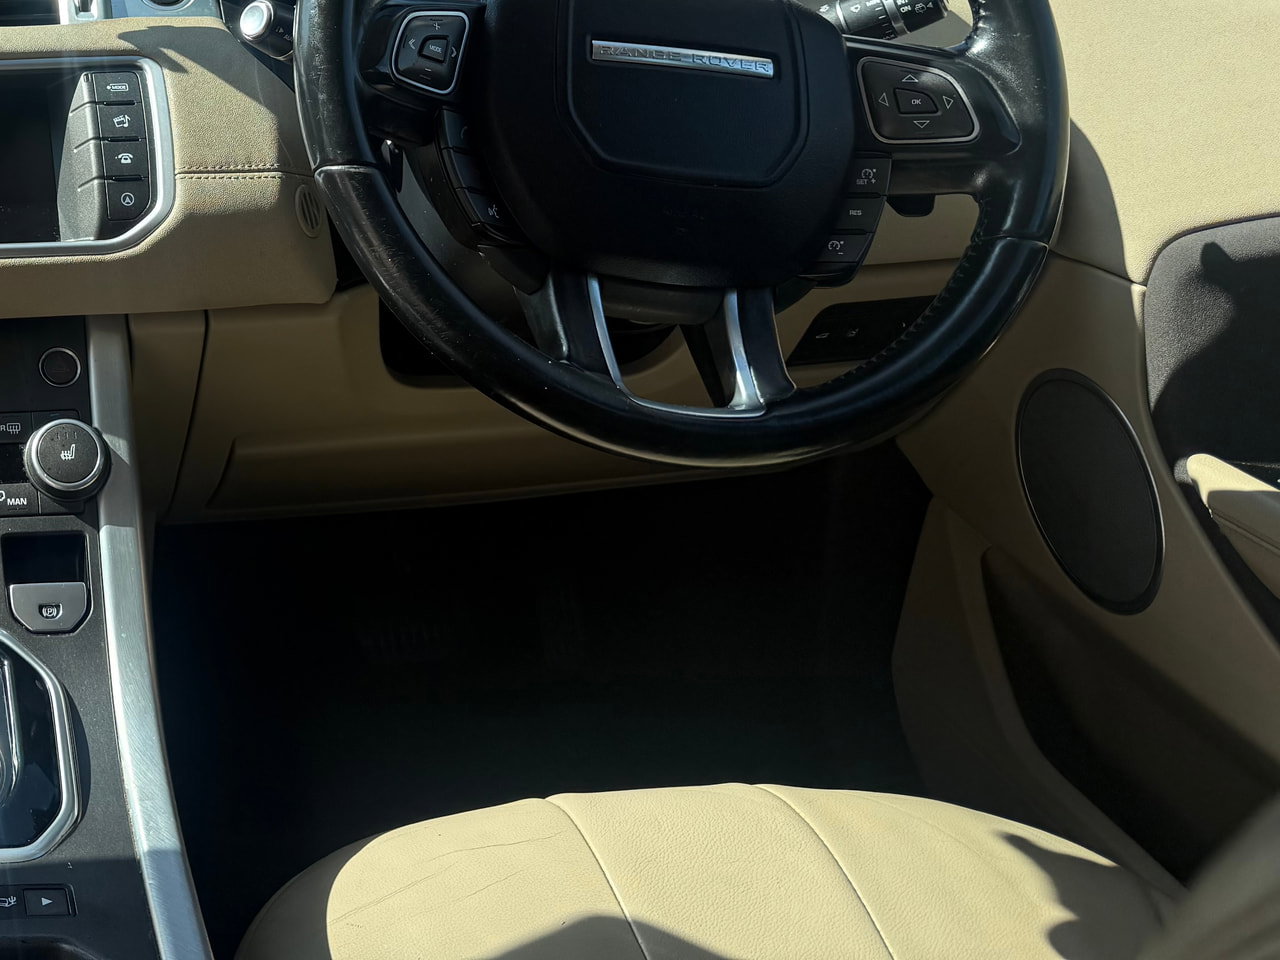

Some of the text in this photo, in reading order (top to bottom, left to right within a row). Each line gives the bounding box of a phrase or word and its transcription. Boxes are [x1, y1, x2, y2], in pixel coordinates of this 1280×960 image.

[900, 4, 912, 13] ON
[429, 44, 442, 53] MODE
[599, 45, 769, 73] RANGE ROVER
[6, 497, 27, 506] MAN
